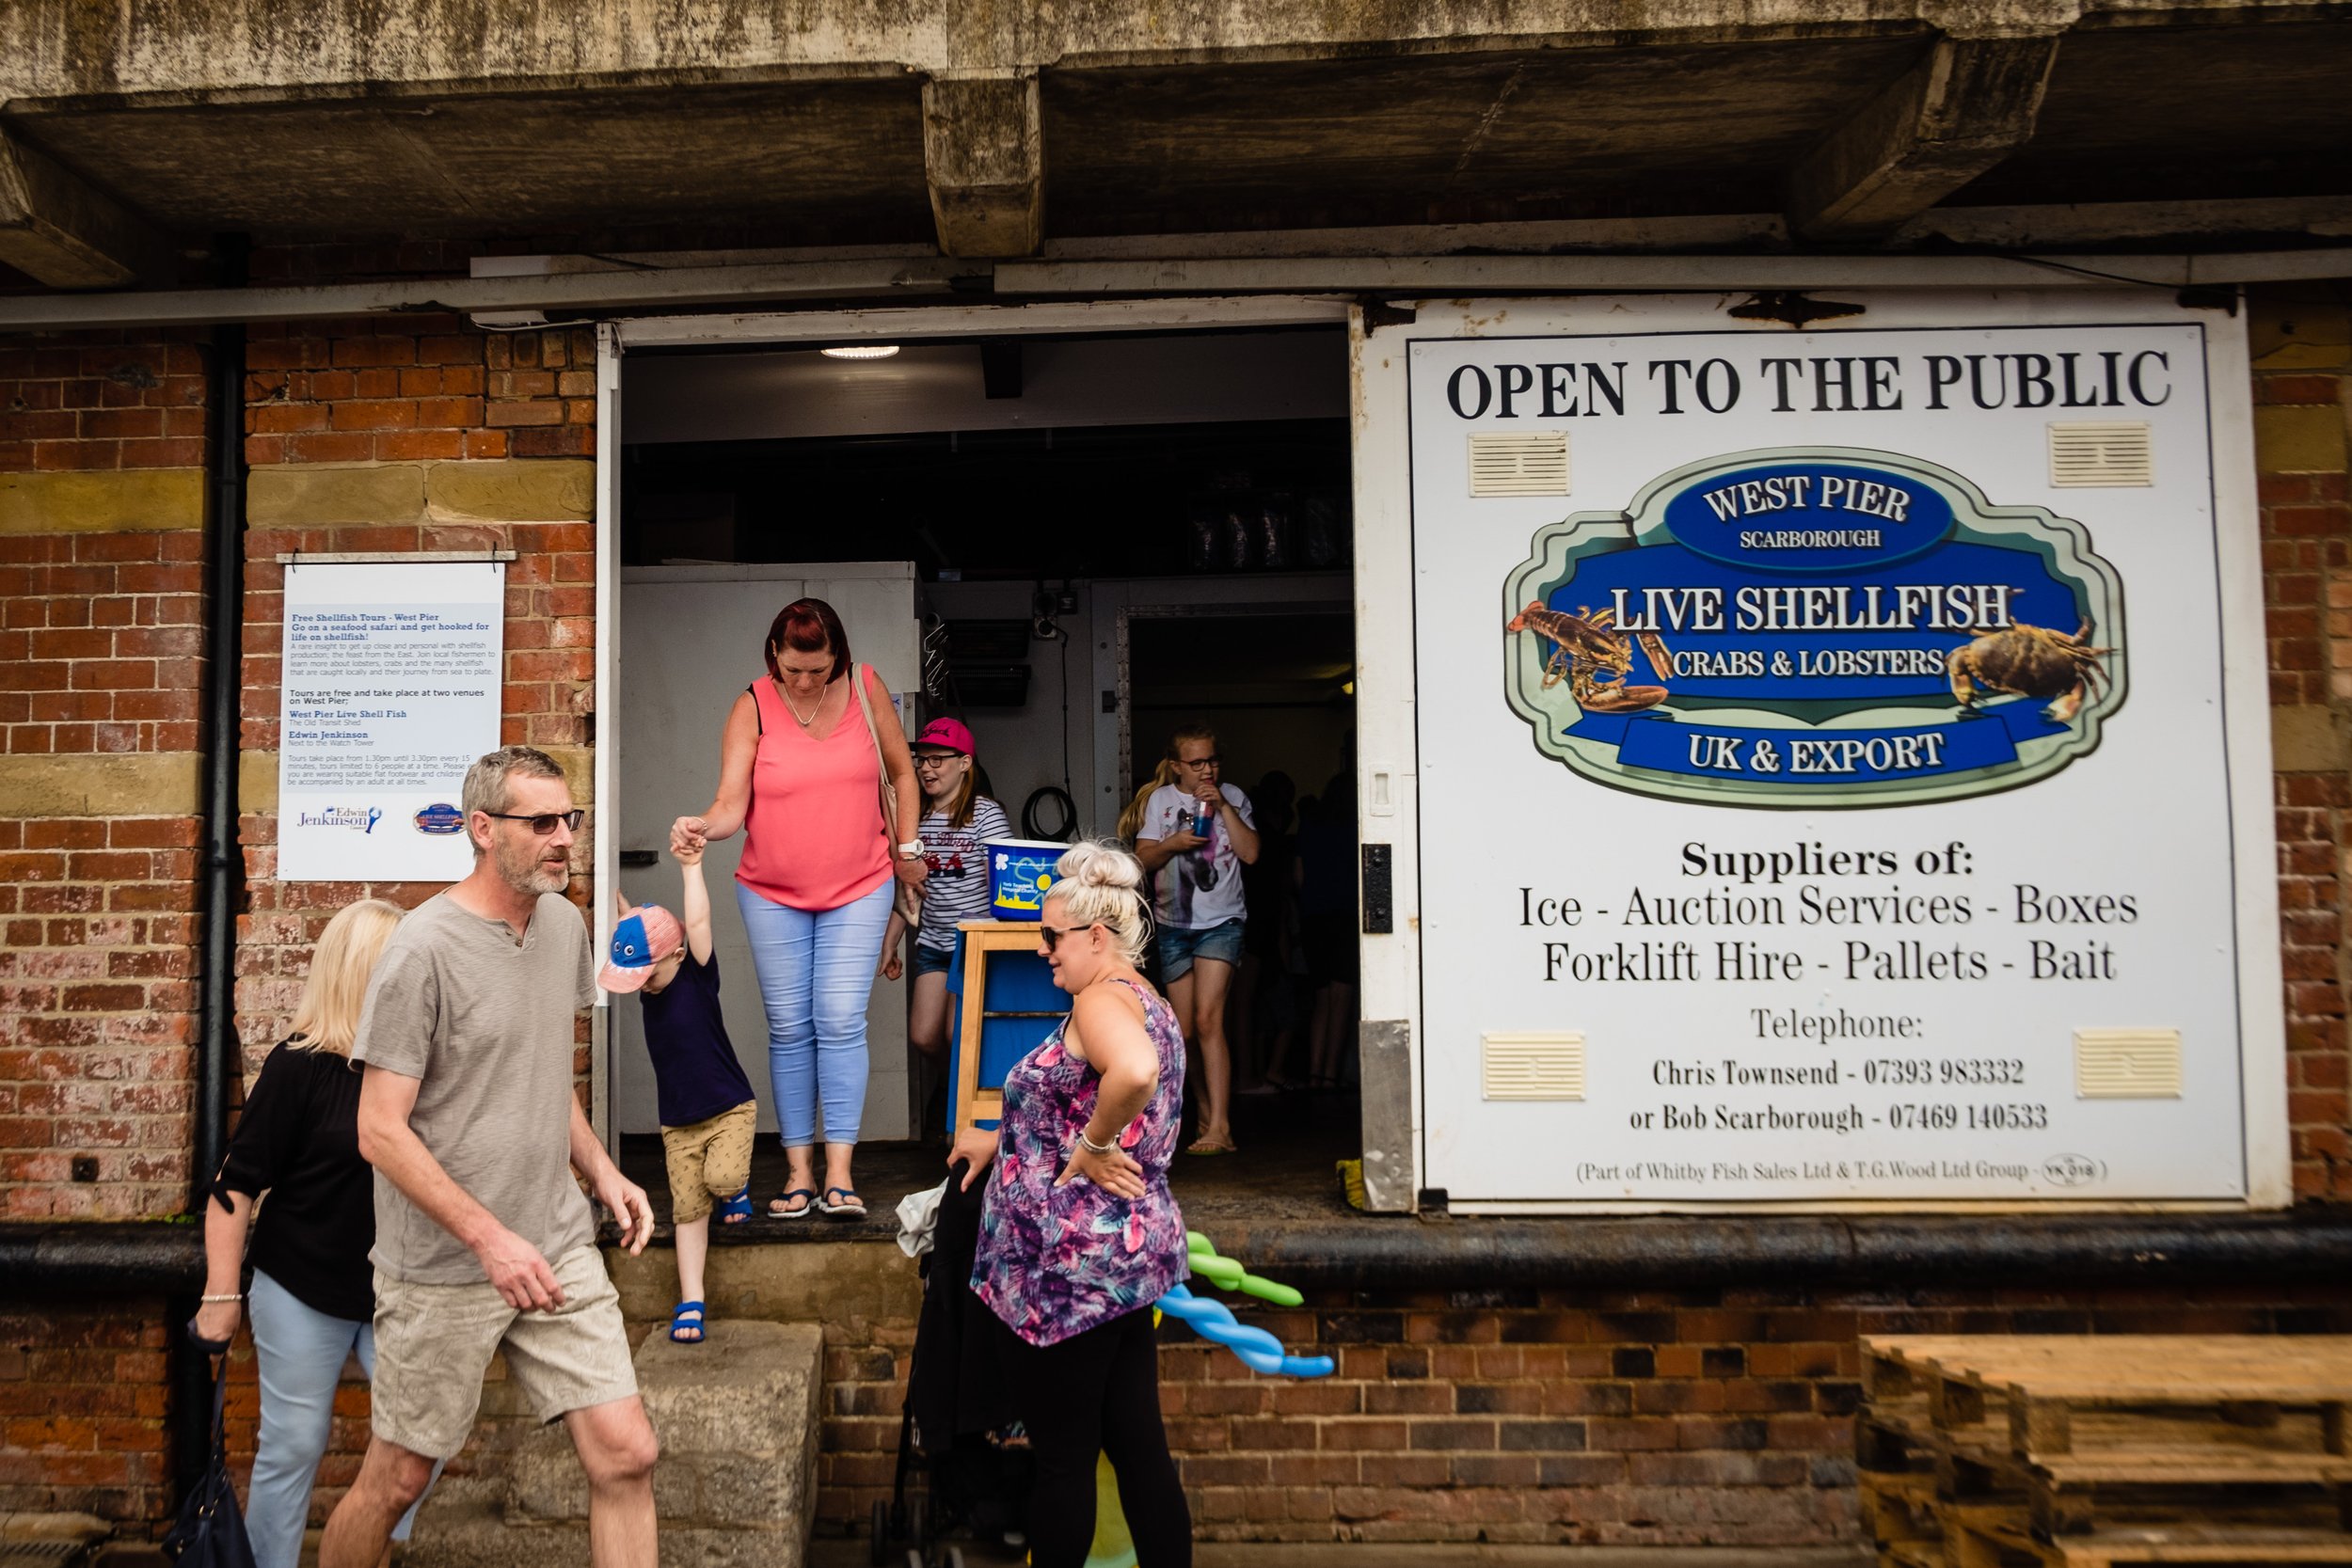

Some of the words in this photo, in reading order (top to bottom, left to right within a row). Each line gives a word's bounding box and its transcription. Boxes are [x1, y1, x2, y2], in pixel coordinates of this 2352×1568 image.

[1447, 362, 1628, 420] OPEN
[1649, 358, 1740, 414] TO
[1761, 356, 1902, 412] THE
[1923, 351, 2170, 409] PUBLIC
[1702, 476, 1811, 524] WEST
[1820, 476, 1911, 523] PIER
[1740, 531, 1881, 548] SCARBOROUGH
[394, 613, 417, 622] West
[1612, 588, 1724, 632] LIVE
[1736, 585, 2010, 630] SHELLFISH
[330, 623, 367, 631] seafood
[370, 623, 397, 631] safari
[421, 624, 436, 633] get
[1673, 651, 1764, 678] CRABS
[1771, 651, 1792, 676] &
[1800, 650, 1945, 676] LOBSTERS
[395, 689, 420, 698] place
[321, 731, 369, 740] Jenkinson
[1688, 735, 1742, 769] UK
[1750, 739, 1780, 772] &
[1788, 734, 1945, 772] EXPORT
[297, 812, 367, 827] Jenkinson
[337, 807, 367, 816] Edwin
[1682, 842, 1898, 883] Suppliers
[1915, 842, 1972, 875] of:
[1519, 888, 1581, 926] Ice
[1623, 887, 1785, 927] Auction
[1801, 885, 1971, 925] Services
[2014, 885, 2137, 923] Boxes
[1543, 942, 1698, 981] Forklift
[1716, 942, 1802, 980] Hire
[1845, 941, 1987, 980] Pallets
[2029, 941, 2116, 980] Bait
[1752, 1008, 1921, 1044] Telephone:
[1654, 1061, 1714, 1085] Chris
[1724, 1060, 1837, 1084] Townsend
[1865, 1060, 1931, 1084] 07393
[1941, 1060, 2023, 1083] 983332
[1630, 1113, 1654, 1129] or
[1664, 1105, 1707, 1129] Bob
[1716, 1104, 1863, 1133] Scarborough
[1890, 1105, 1957, 1128] 07469
[1969, 1105, 2046, 1128] 140533
[1576, 1164, 1620, 1182] (Part
[1625, 1164, 1643, 1180] of
[1645, 1164, 1705, 1182] Whitby
[1712, 1164, 1748, 1180] Fish
[1753, 1164, 1798, 1179] Sales
[1804, 1163, 1832, 1179] Ltd
[1836, 1163, 1850, 1178] &
[1942, 1162, 1971, 1178] Ltd
[1976, 1162, 2029, 1181] Group
